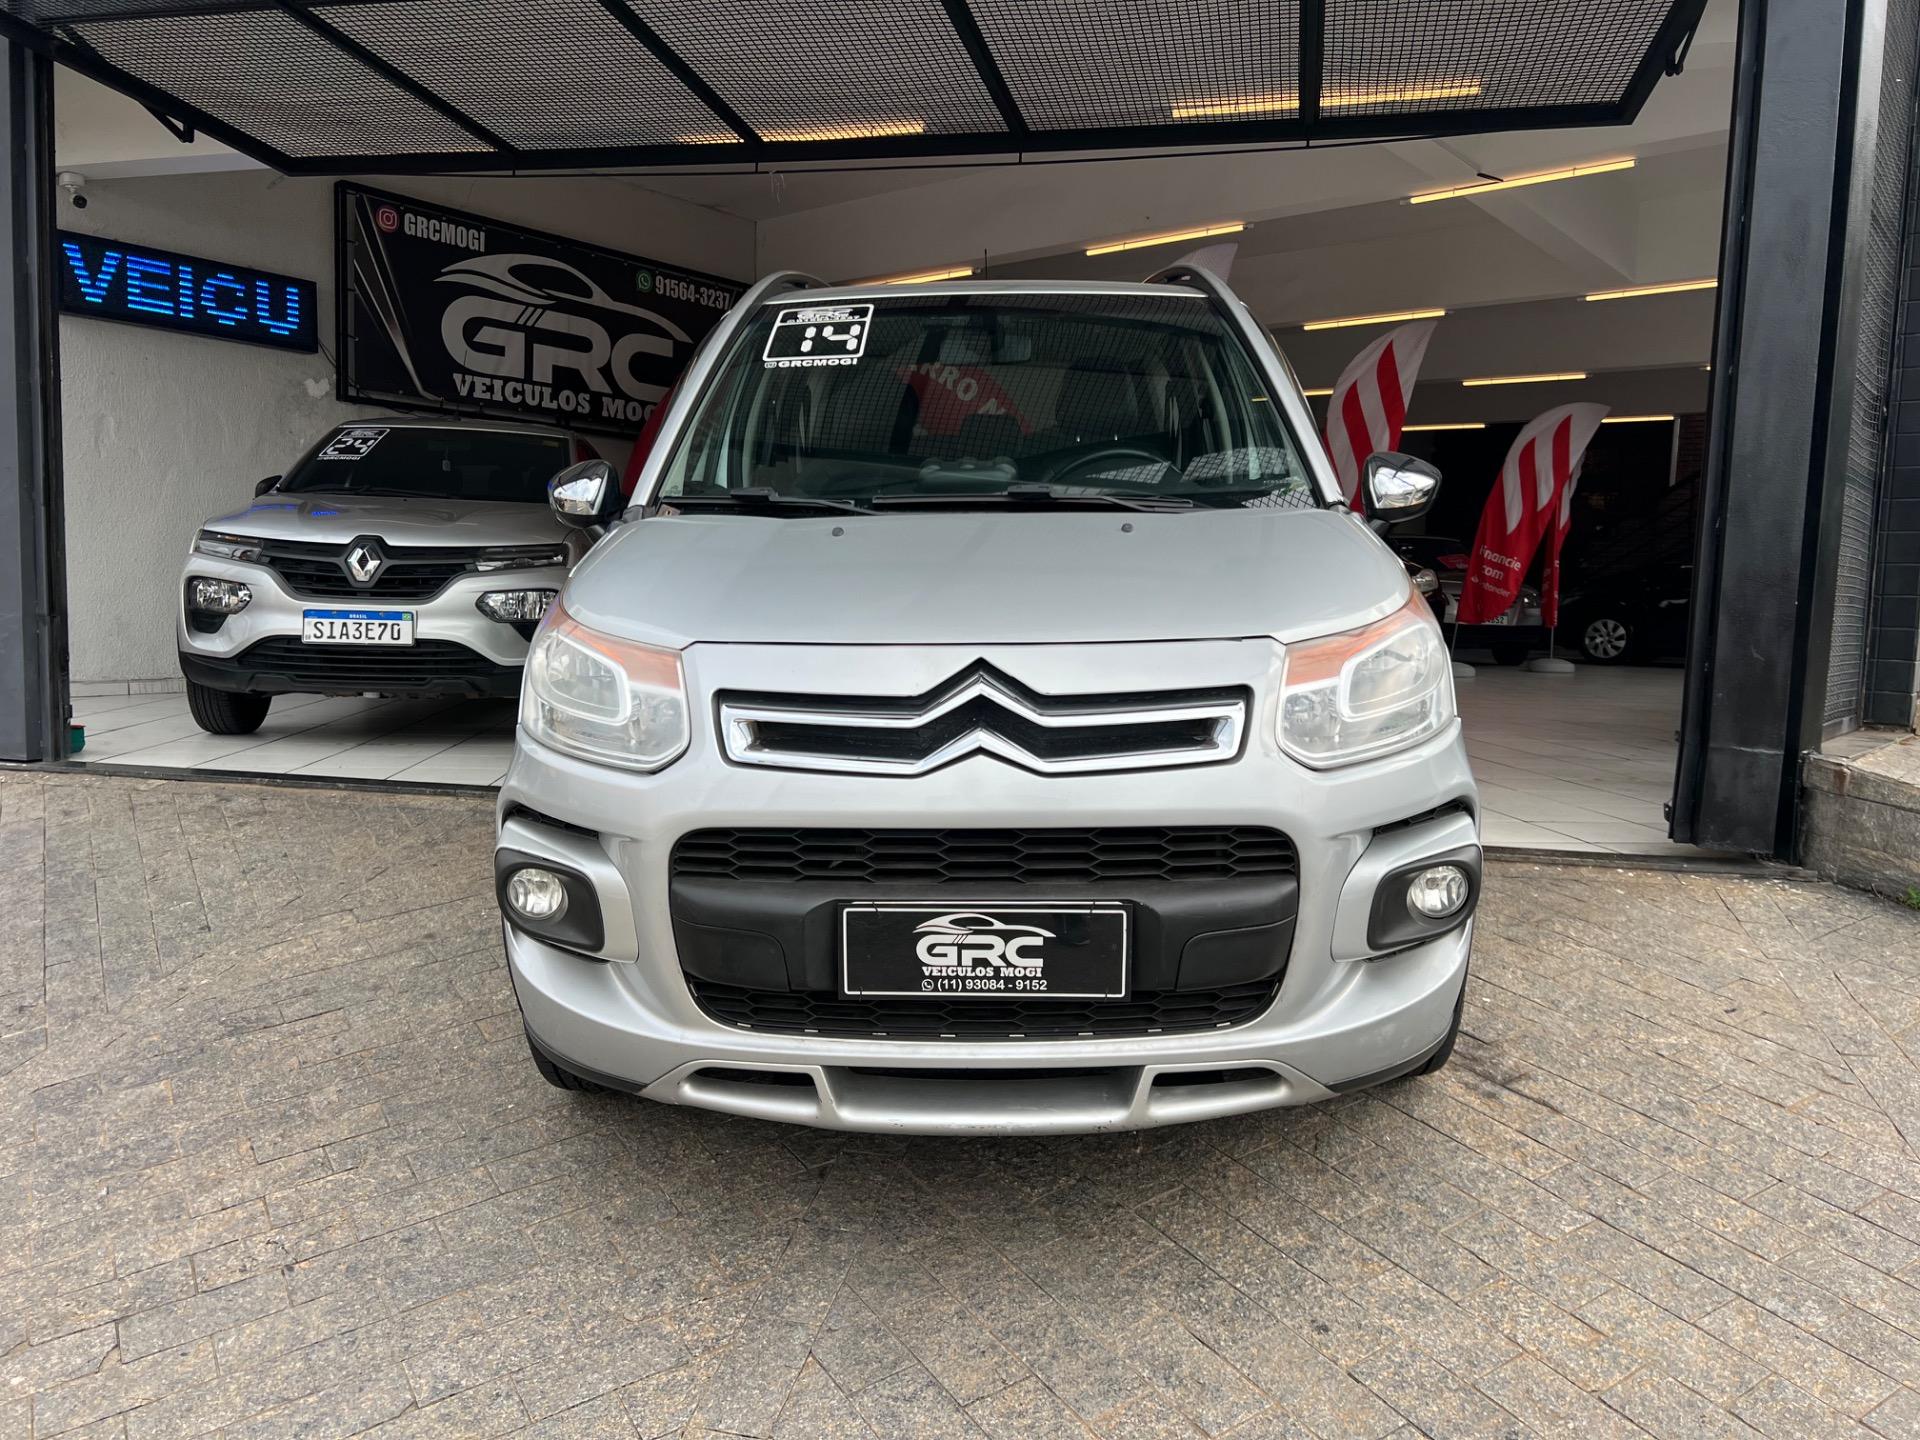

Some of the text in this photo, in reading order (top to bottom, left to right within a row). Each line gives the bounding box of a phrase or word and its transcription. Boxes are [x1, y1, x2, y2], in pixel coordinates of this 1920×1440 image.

[404, 213, 486, 252] GRCMOGI
[62, 243, 300, 335] VEICU
[655, 275, 731, 310] 91564-3237
[441, 295, 675, 401] GRC
[800, 324, 861, 352] 14
[778, 358, 858, 367] GRCMOGI
[453, 373, 590, 414] VEICULOS
[326, 438, 374, 454] 24
[1480, 544, 1521, 571] inancie
[916, 934, 1044, 967] GRC
[922, 966, 1042, 977] VEICULOS MOGI
[938, 979, 962, 992] (11)
[966, 979, 1005, 991] 93084
[1016, 979, 1048, 991] 9152
